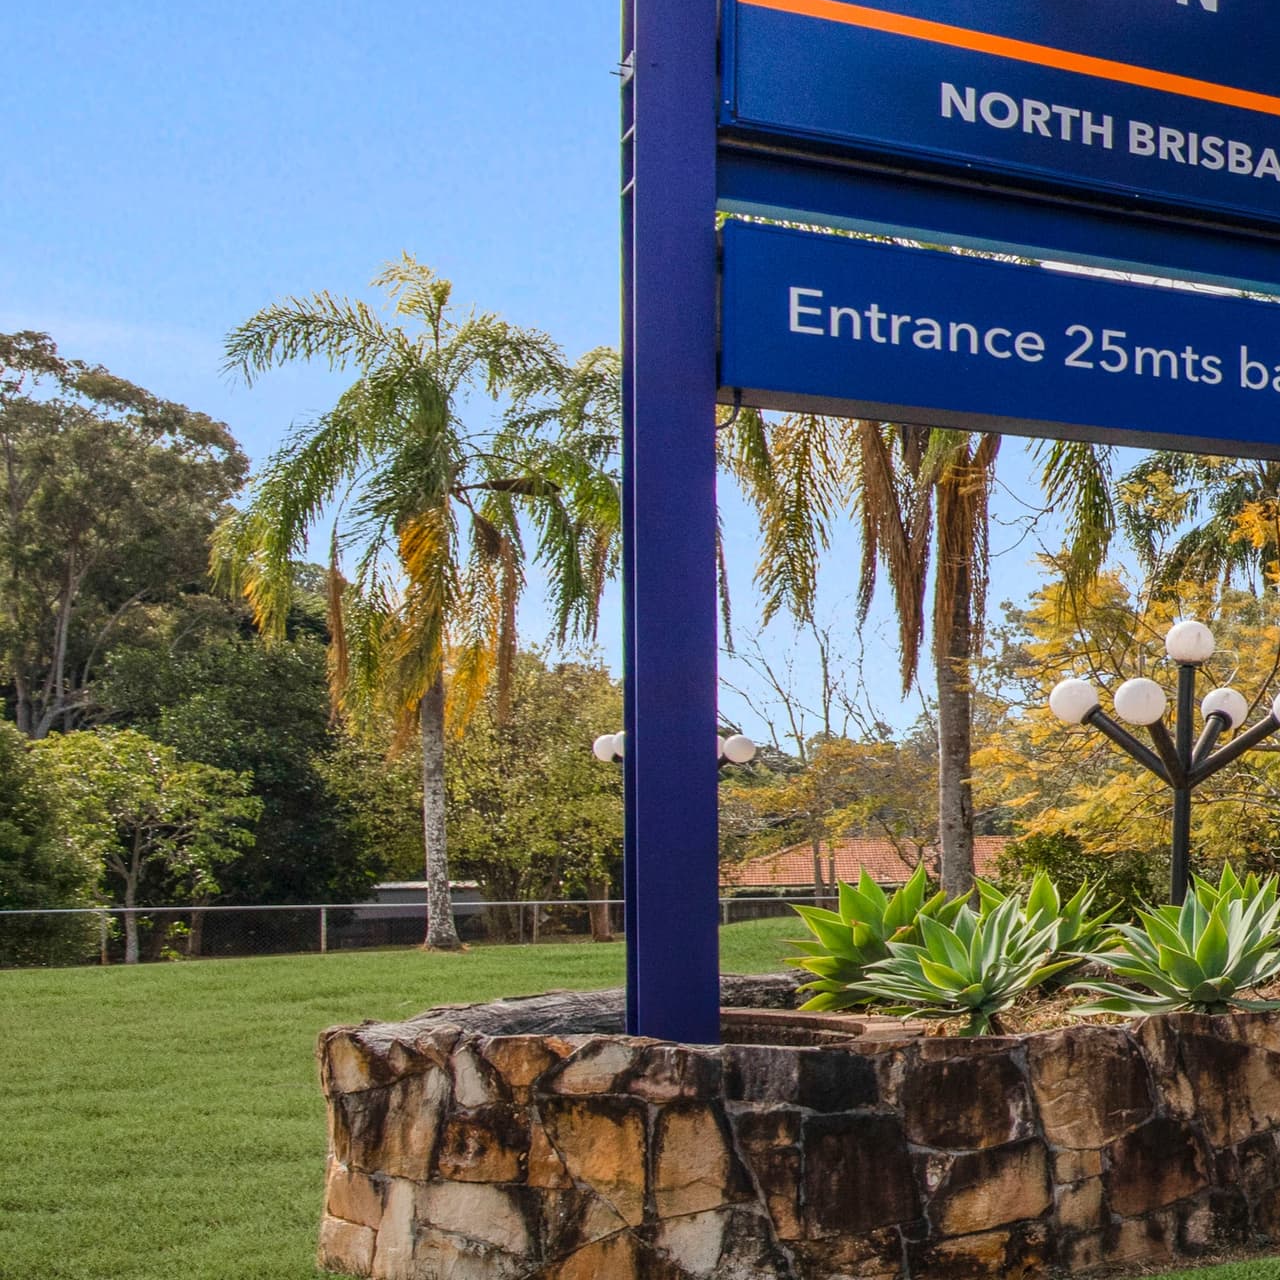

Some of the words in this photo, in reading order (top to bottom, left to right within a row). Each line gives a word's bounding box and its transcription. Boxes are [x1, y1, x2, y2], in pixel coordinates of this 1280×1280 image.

[940, 82, 1114, 149] NORTH
[788, 286, 1046, 362] Entrance
[1063, 324, 1223, 386] 25mts
